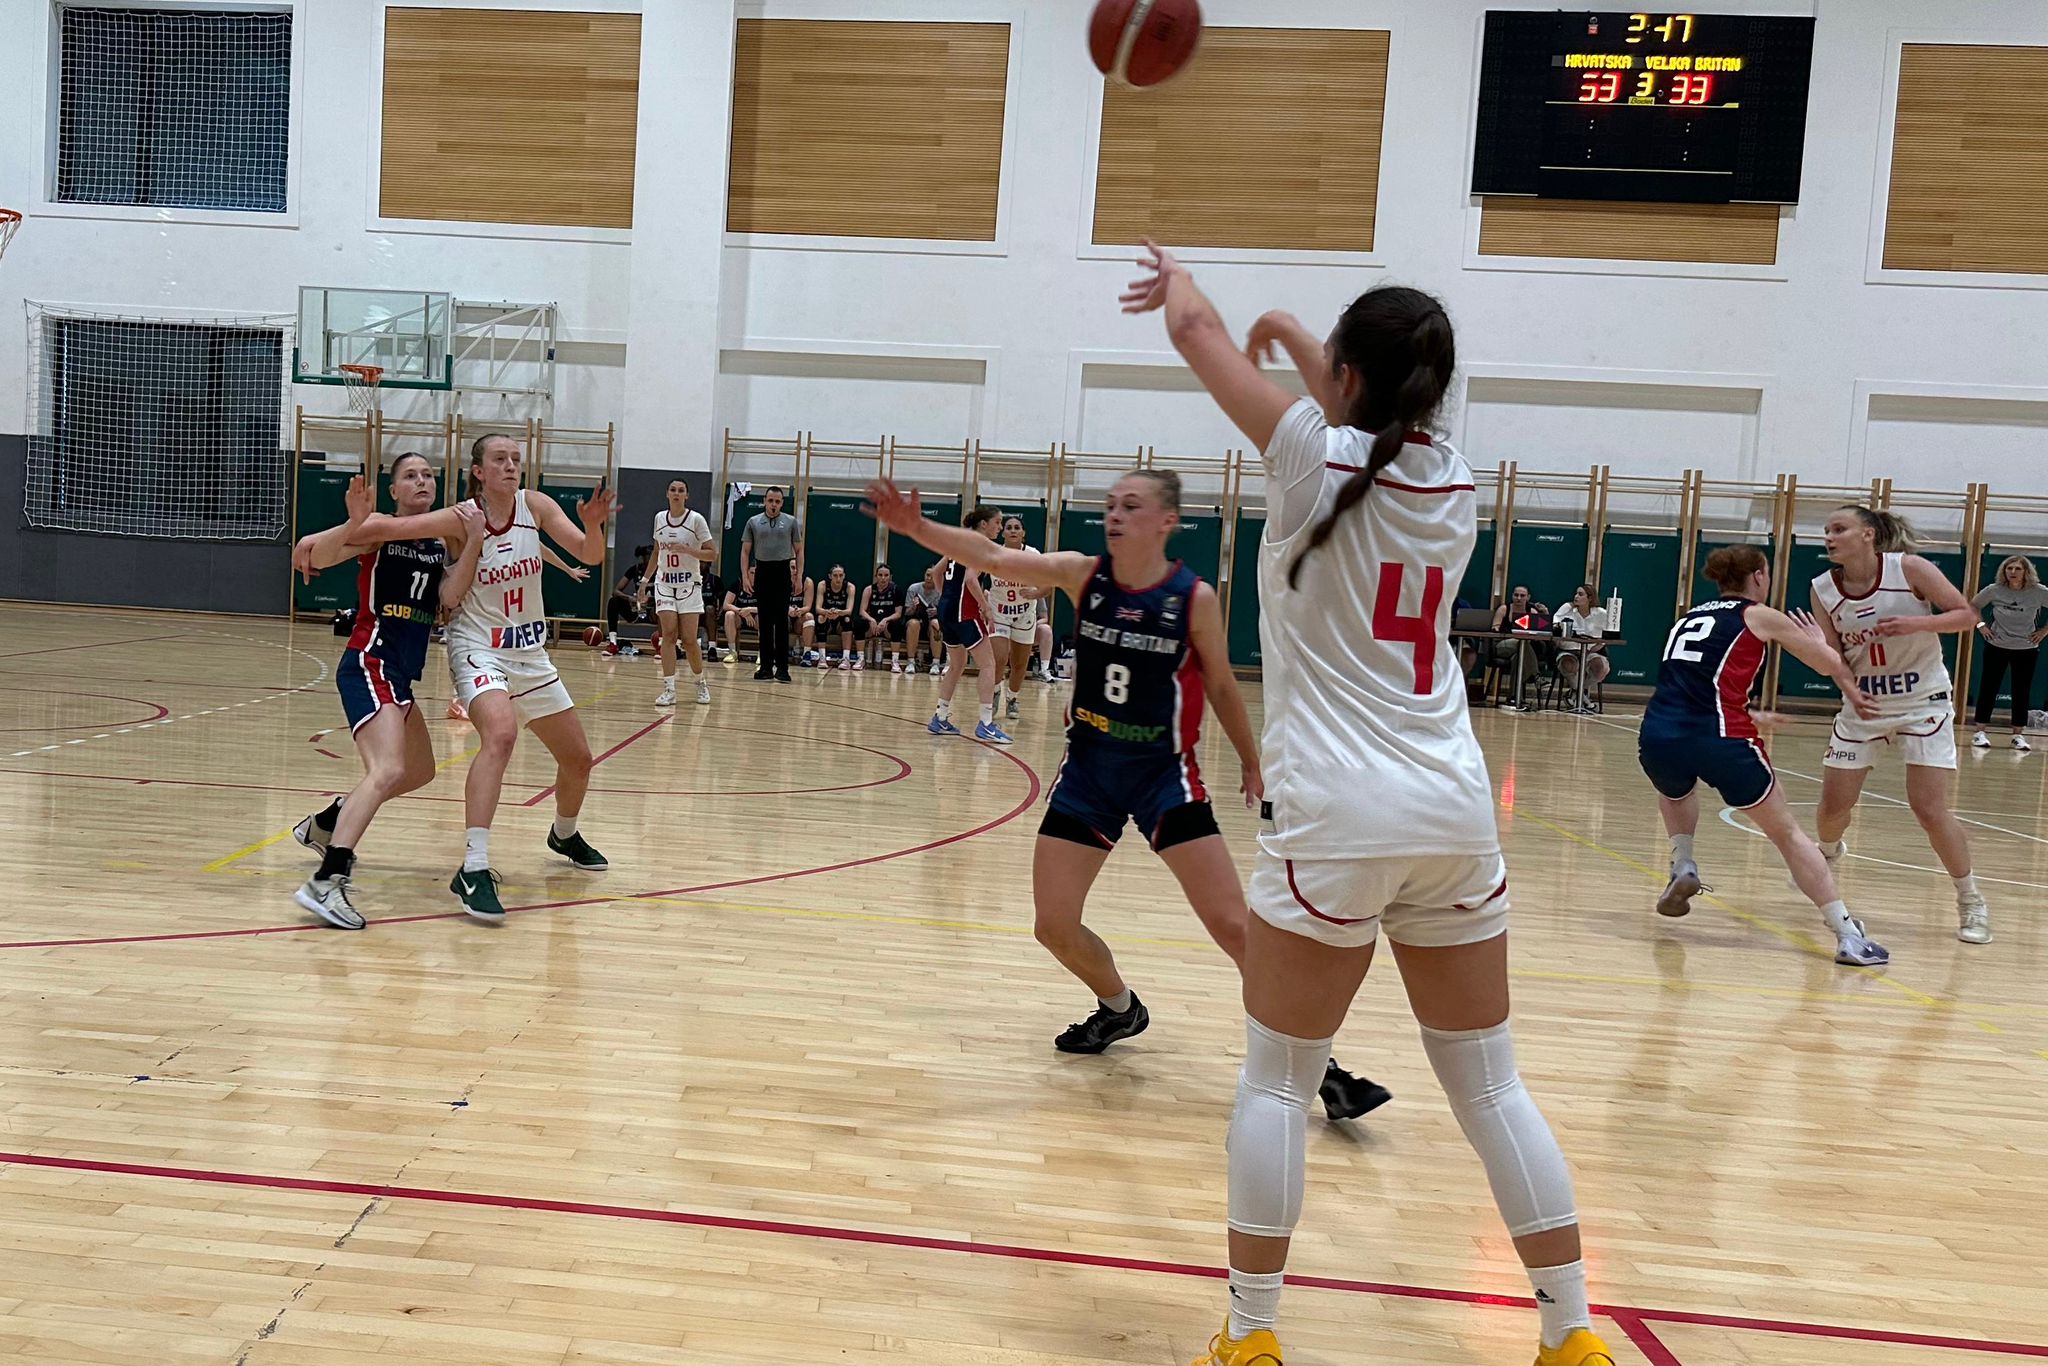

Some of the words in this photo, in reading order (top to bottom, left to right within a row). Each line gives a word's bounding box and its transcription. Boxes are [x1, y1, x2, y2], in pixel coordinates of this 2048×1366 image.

[1564, 54, 1633, 69] HRVATSKA
[1645, 56, 1691, 71] VELIKA
[1694, 57, 1742, 72] BRITAN
[1578, 72, 1621, 103] 53
[1635, 71, 1654, 98] 3
[1668, 73, 1714, 105] 33
[387, 543, 418, 561] GREAT
[417, 553, 443, 564] BRIT
[666, 554, 680, 568] 10
[478, 555, 542, 586] CROATIA
[670, 572, 692, 584] HEP
[409, 570, 430, 600] 11
[1006, 590, 1017, 602] 9
[381, 603, 435, 624] SUBWA
[503, 586, 524, 618] 14
[1009, 602, 1031, 615] HEP
[515, 620, 546, 649] HEP
[1079, 619, 1121, 646] GREAT
[1120, 631, 1181, 655] BRITAIN
[1371, 561, 1444, 695] 4
[1662, 615, 1716, 662] 12
[1868, 642, 1887, 667] 11
[1103, 662, 1132, 704] 8
[1870, 672, 1921, 696] HEP
[1074, 706, 1167, 743] SUBWAY
[1831, 750, 1857, 761] HPB
